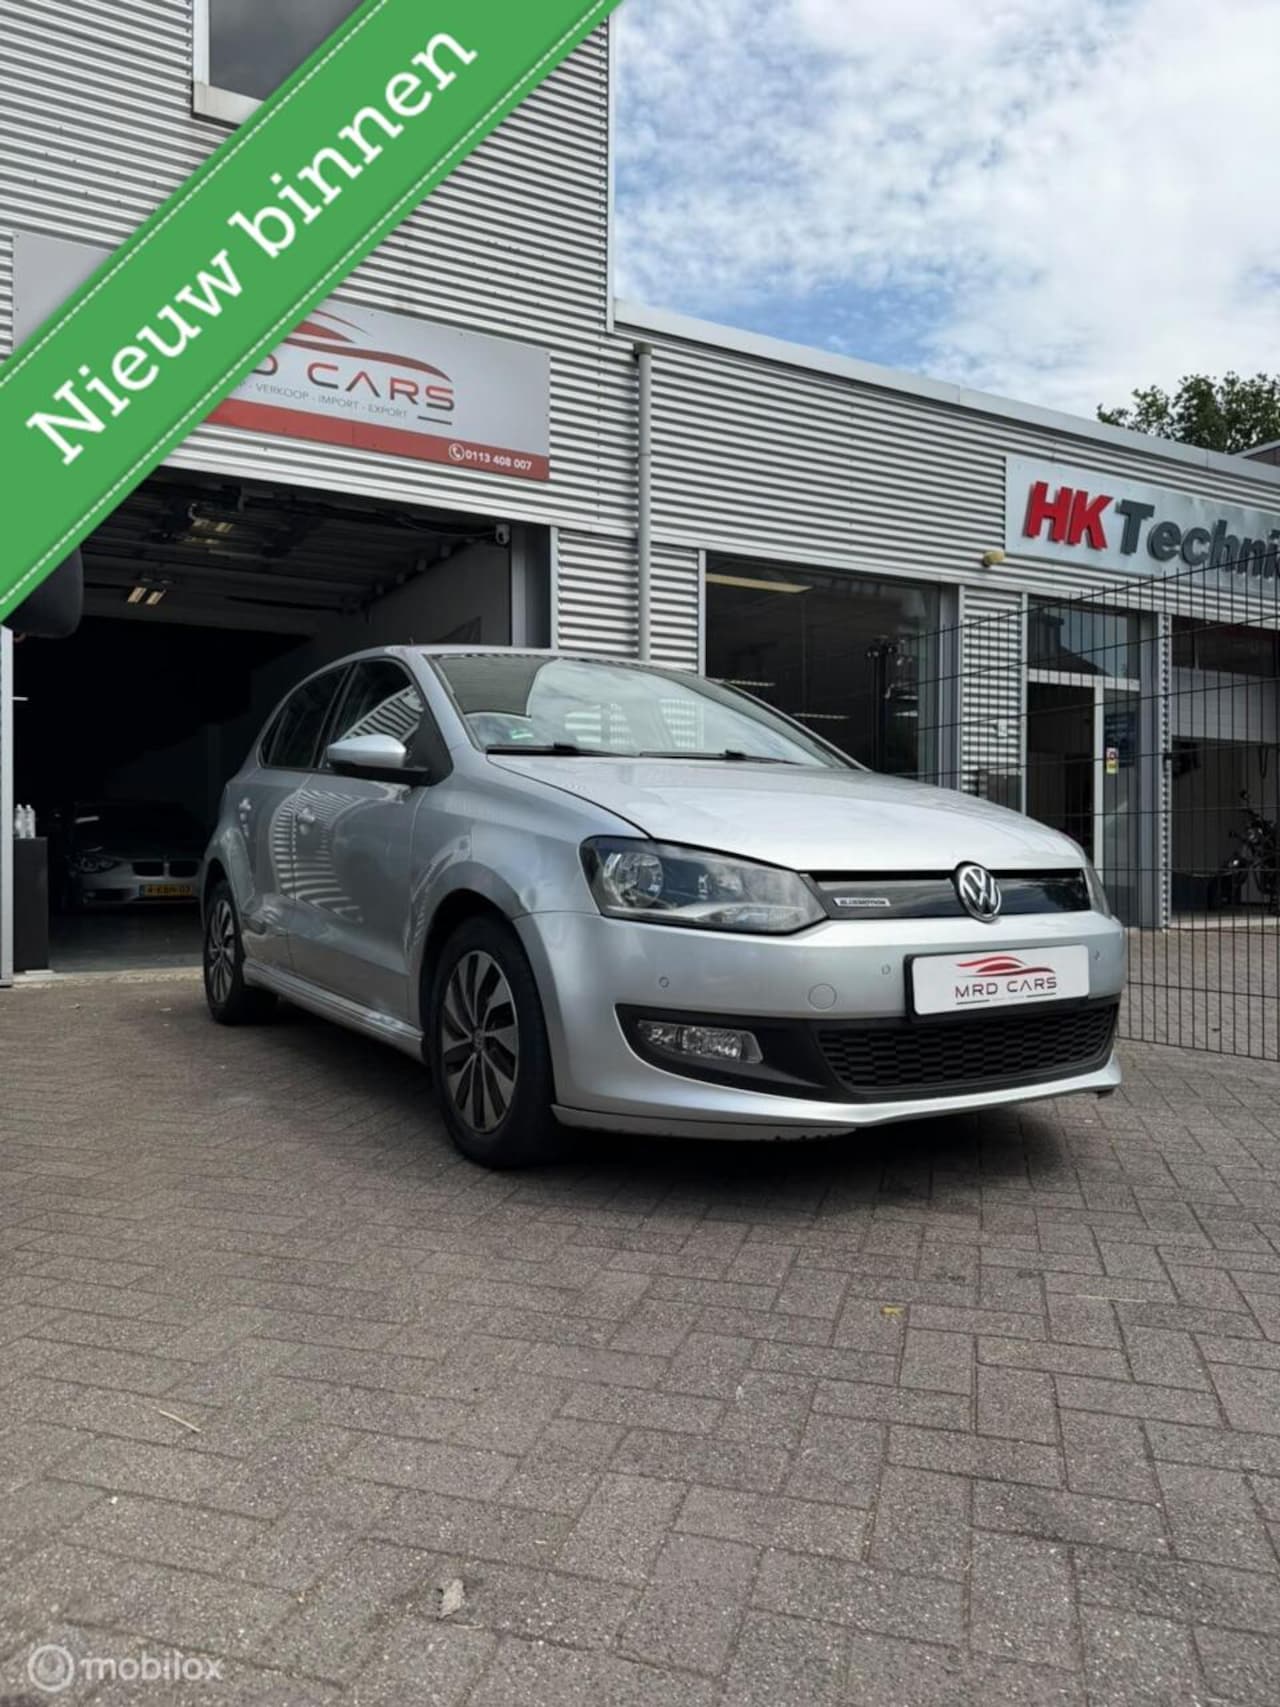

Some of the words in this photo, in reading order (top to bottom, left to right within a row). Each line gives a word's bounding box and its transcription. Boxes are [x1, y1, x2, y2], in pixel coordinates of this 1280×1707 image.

[255, 382, 310, 402] VERKOOP
[318, 394, 359, 410] IMPORT
[307, 362, 455, 412] CARS
[465, 451, 491, 463] 0113
[493, 456, 512, 468] 408
[513, 459, 533, 471] 007
[1115, 498, 1280, 579] Techni
[955, 982, 998, 999] MRD
[1006, 976, 1057, 993] CARS
